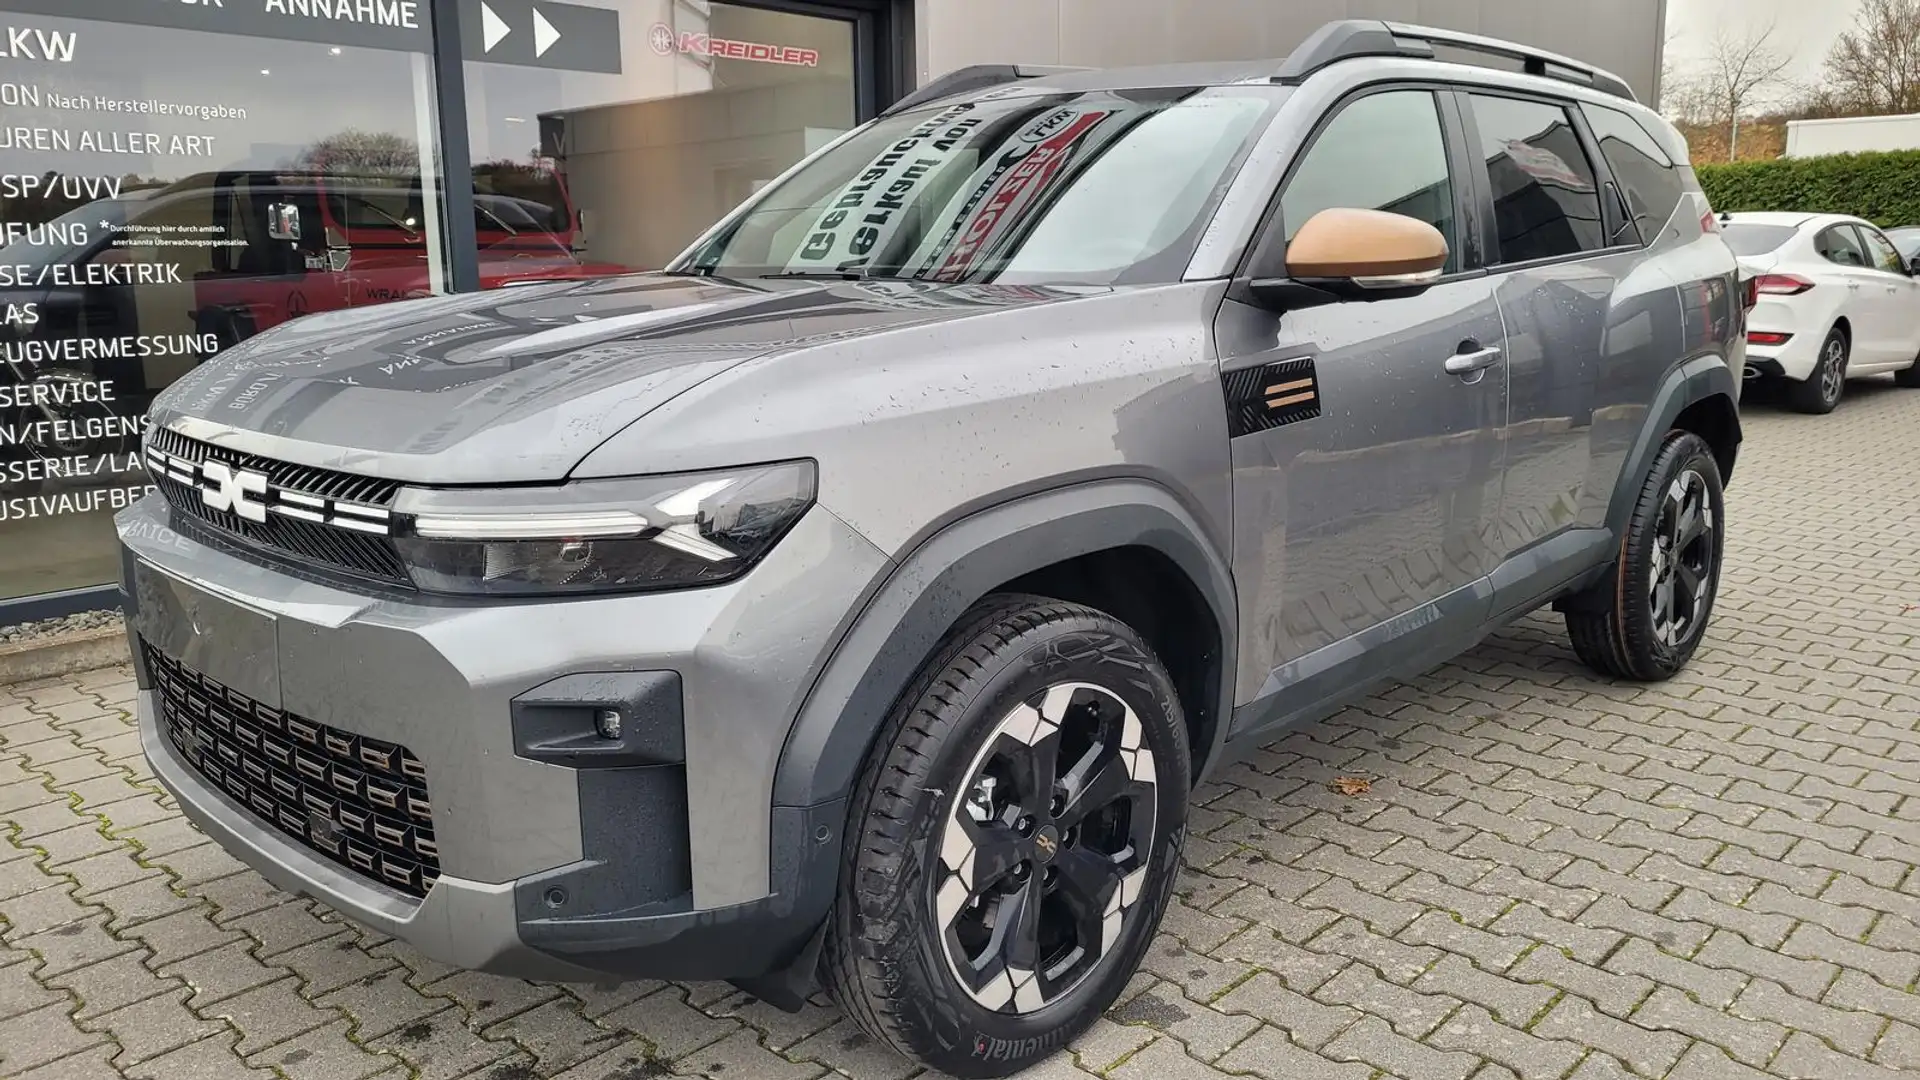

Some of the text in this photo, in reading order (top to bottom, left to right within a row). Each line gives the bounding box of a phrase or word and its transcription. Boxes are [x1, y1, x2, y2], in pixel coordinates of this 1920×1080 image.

[679, 31, 818, 67] KREIDLER
[47, 93, 90, 110] Nach
[95, 96, 247, 120] Herstellervorgaben
[79, 130, 161, 155] ALLER
[169, 135, 215, 156] ART
[2, 174, 121, 200] SP/UVV
[0, 222, 88, 246] FUNG
[110, 224, 161, 234] Durchführung
[162, 225, 177, 233] hier
[177, 225, 198, 233] durch
[0, 263, 182, 287] SE/ELEKTRIK
[0, 302, 39, 325] AS
[0, 380, 116, 409] SERVICE
